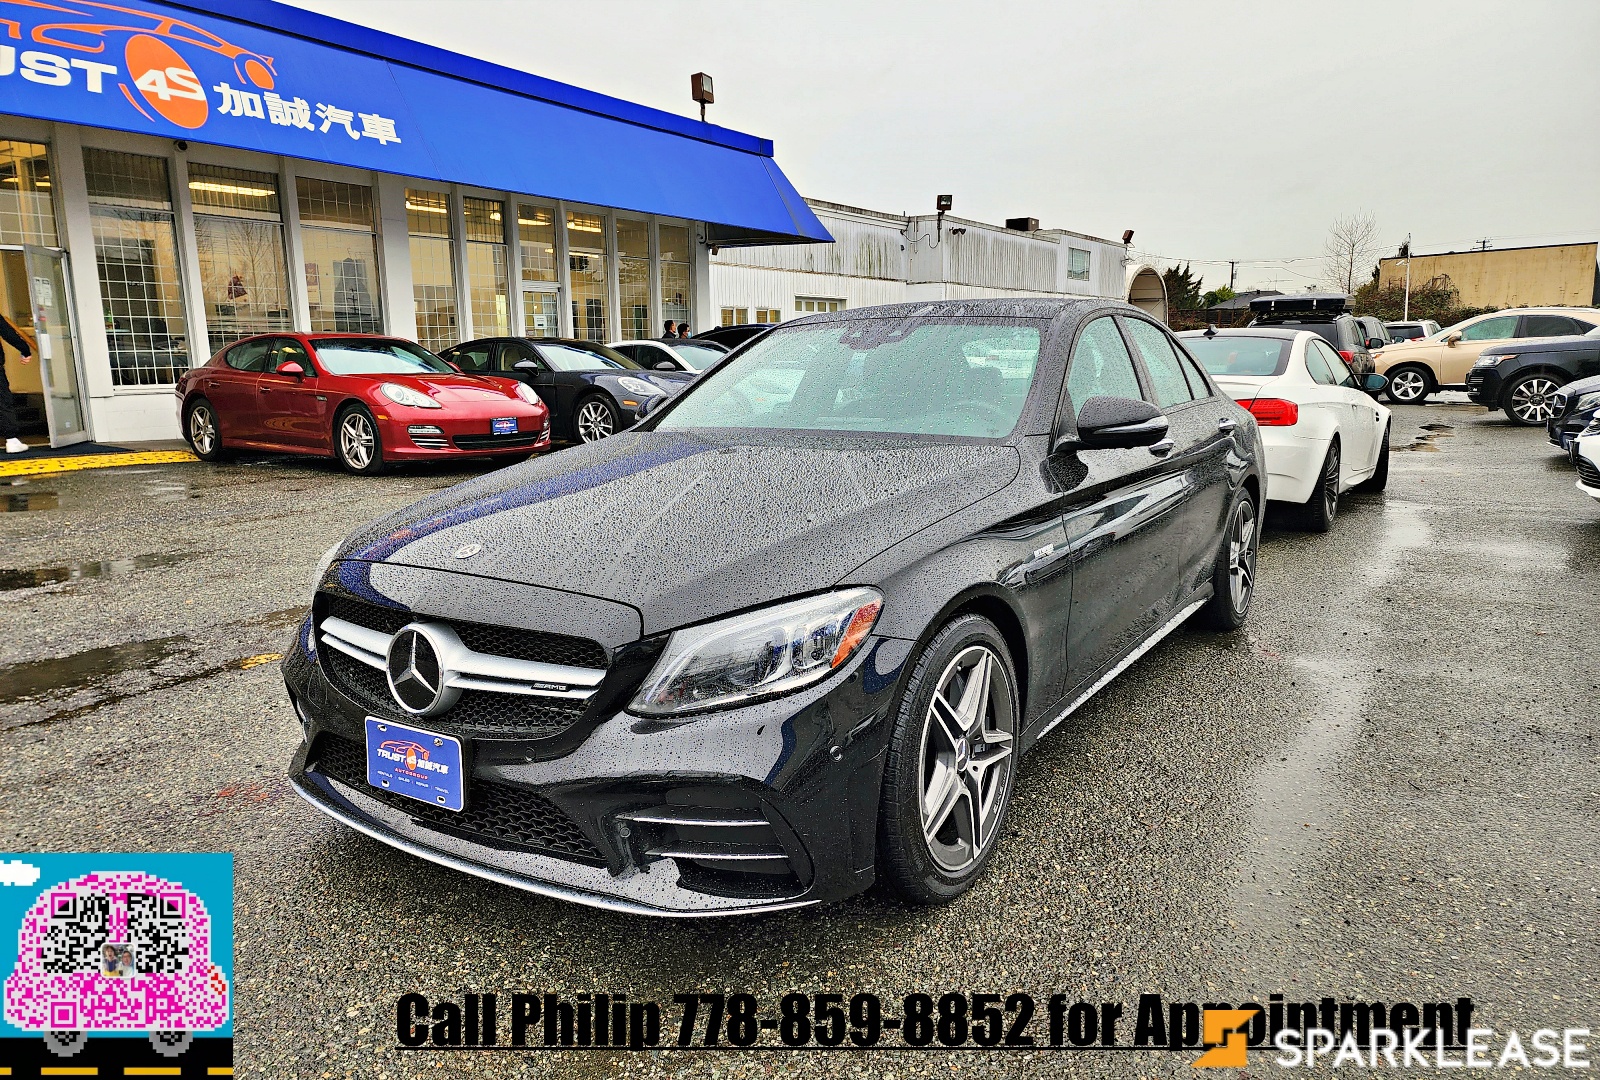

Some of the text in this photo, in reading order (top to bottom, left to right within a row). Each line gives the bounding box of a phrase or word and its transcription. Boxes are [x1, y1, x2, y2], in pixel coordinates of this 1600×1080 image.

[135, 67, 206, 101] 4S
[213, 82, 402, 145] 加誠汽車
[377, 749, 406, 763] TRUST
[395, 767, 428, 780] AUTOGROUP
